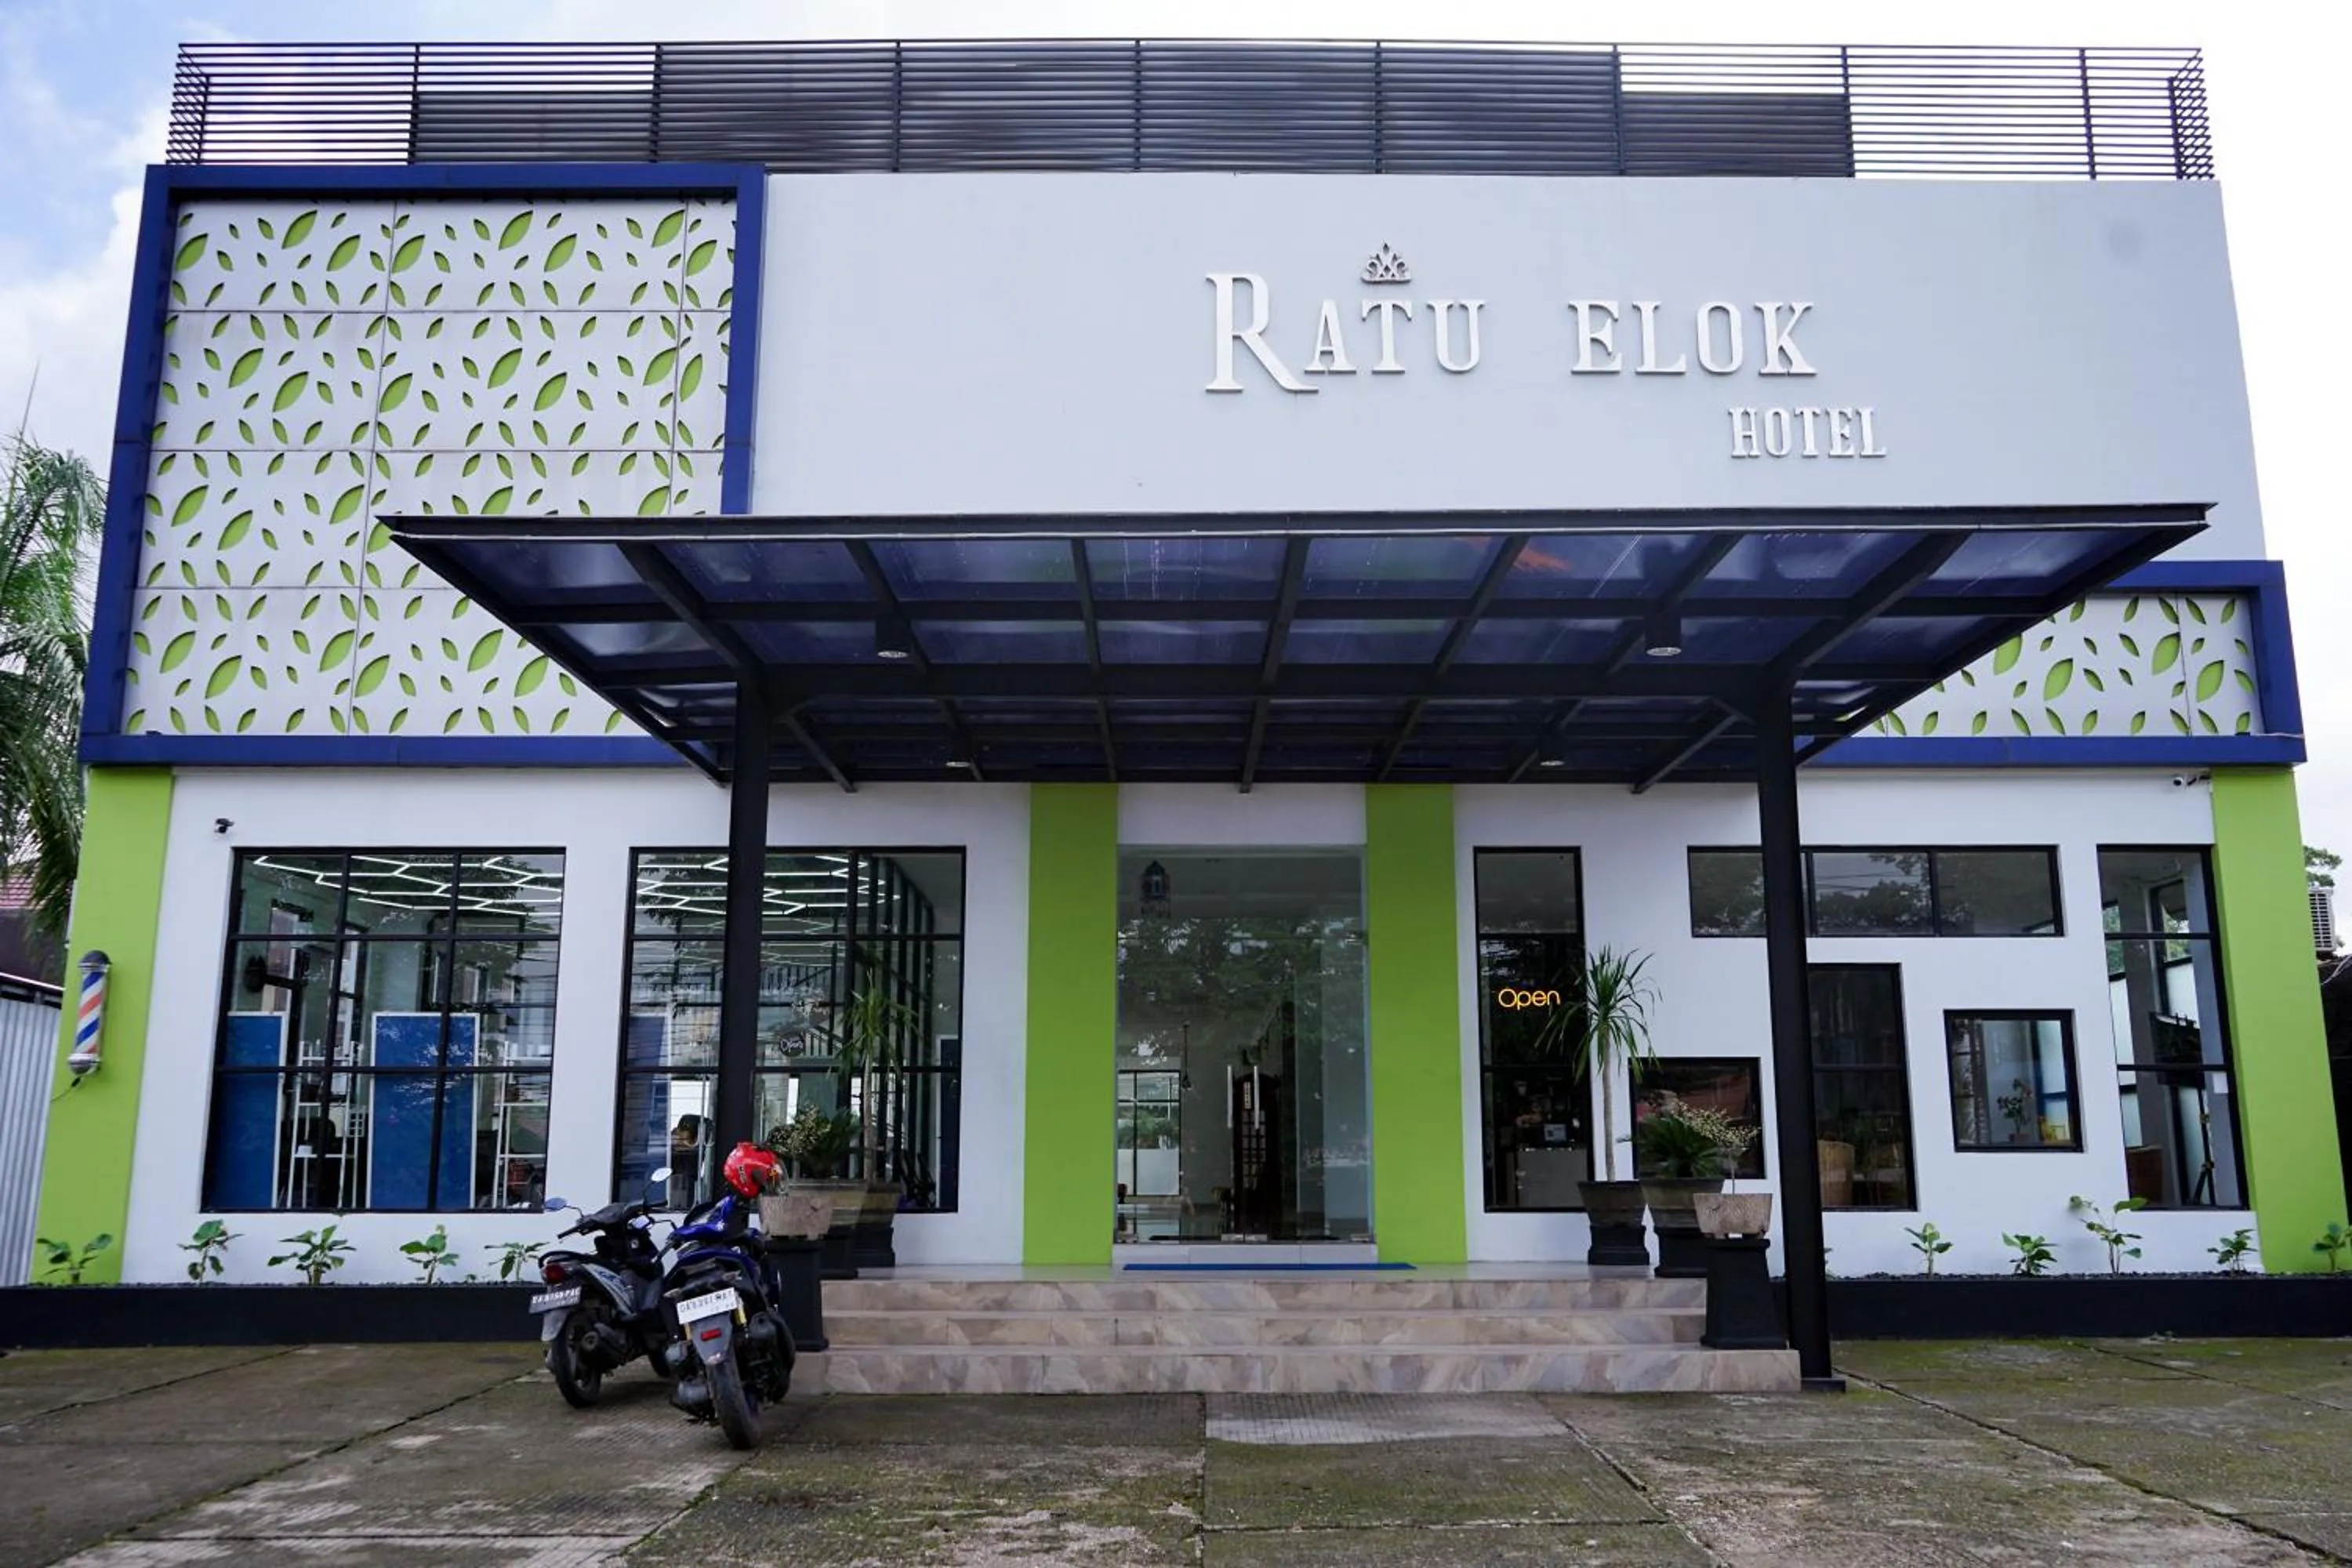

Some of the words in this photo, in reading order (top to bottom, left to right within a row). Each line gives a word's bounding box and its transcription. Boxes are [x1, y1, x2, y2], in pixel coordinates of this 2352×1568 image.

[1205, 271, 1486, 394] RATU
[1568, 299, 1818, 376] ELOK
[1729, 405, 1886, 459] HOTEL
[1498, 989, 1561, 1011] Open
